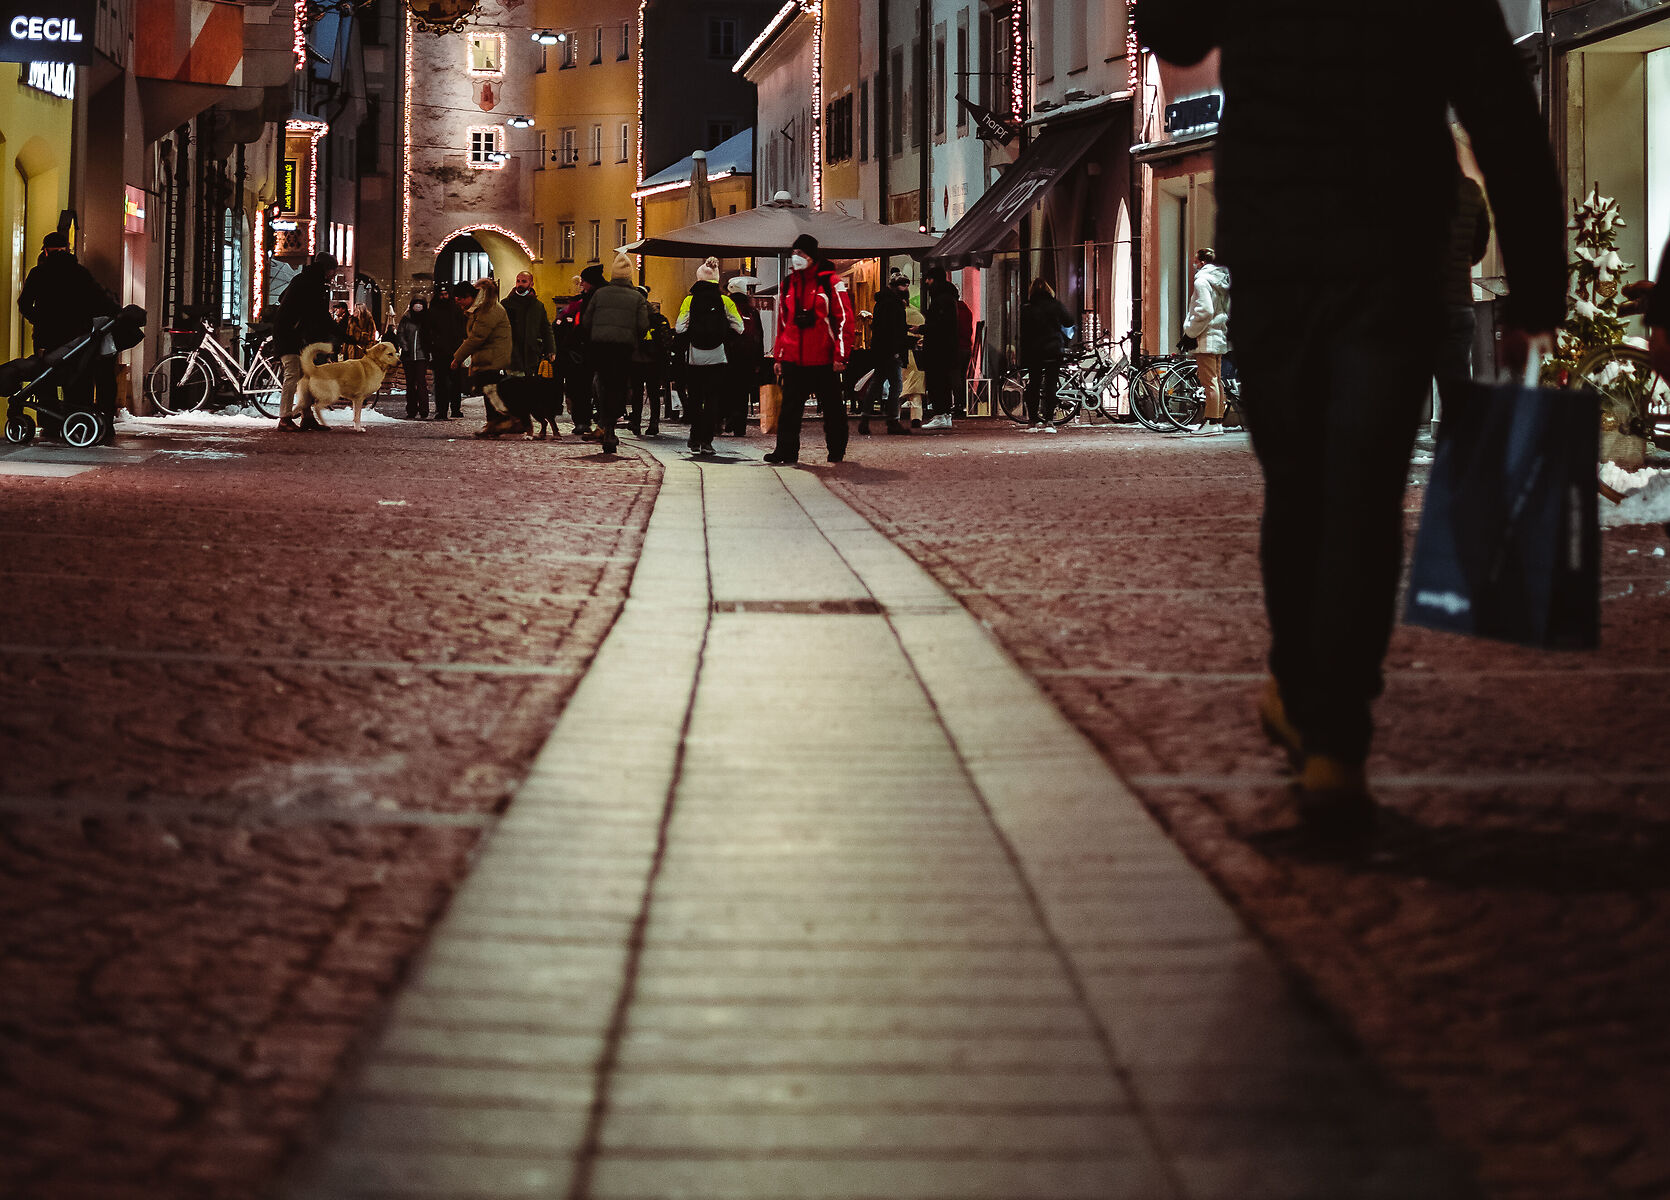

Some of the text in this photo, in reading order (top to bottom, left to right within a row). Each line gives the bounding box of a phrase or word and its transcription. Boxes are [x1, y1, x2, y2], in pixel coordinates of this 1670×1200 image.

[10, 15, 83, 42] CECIL
[982, 113, 1009, 139] harpf
[284, 196, 292, 209] Jack
